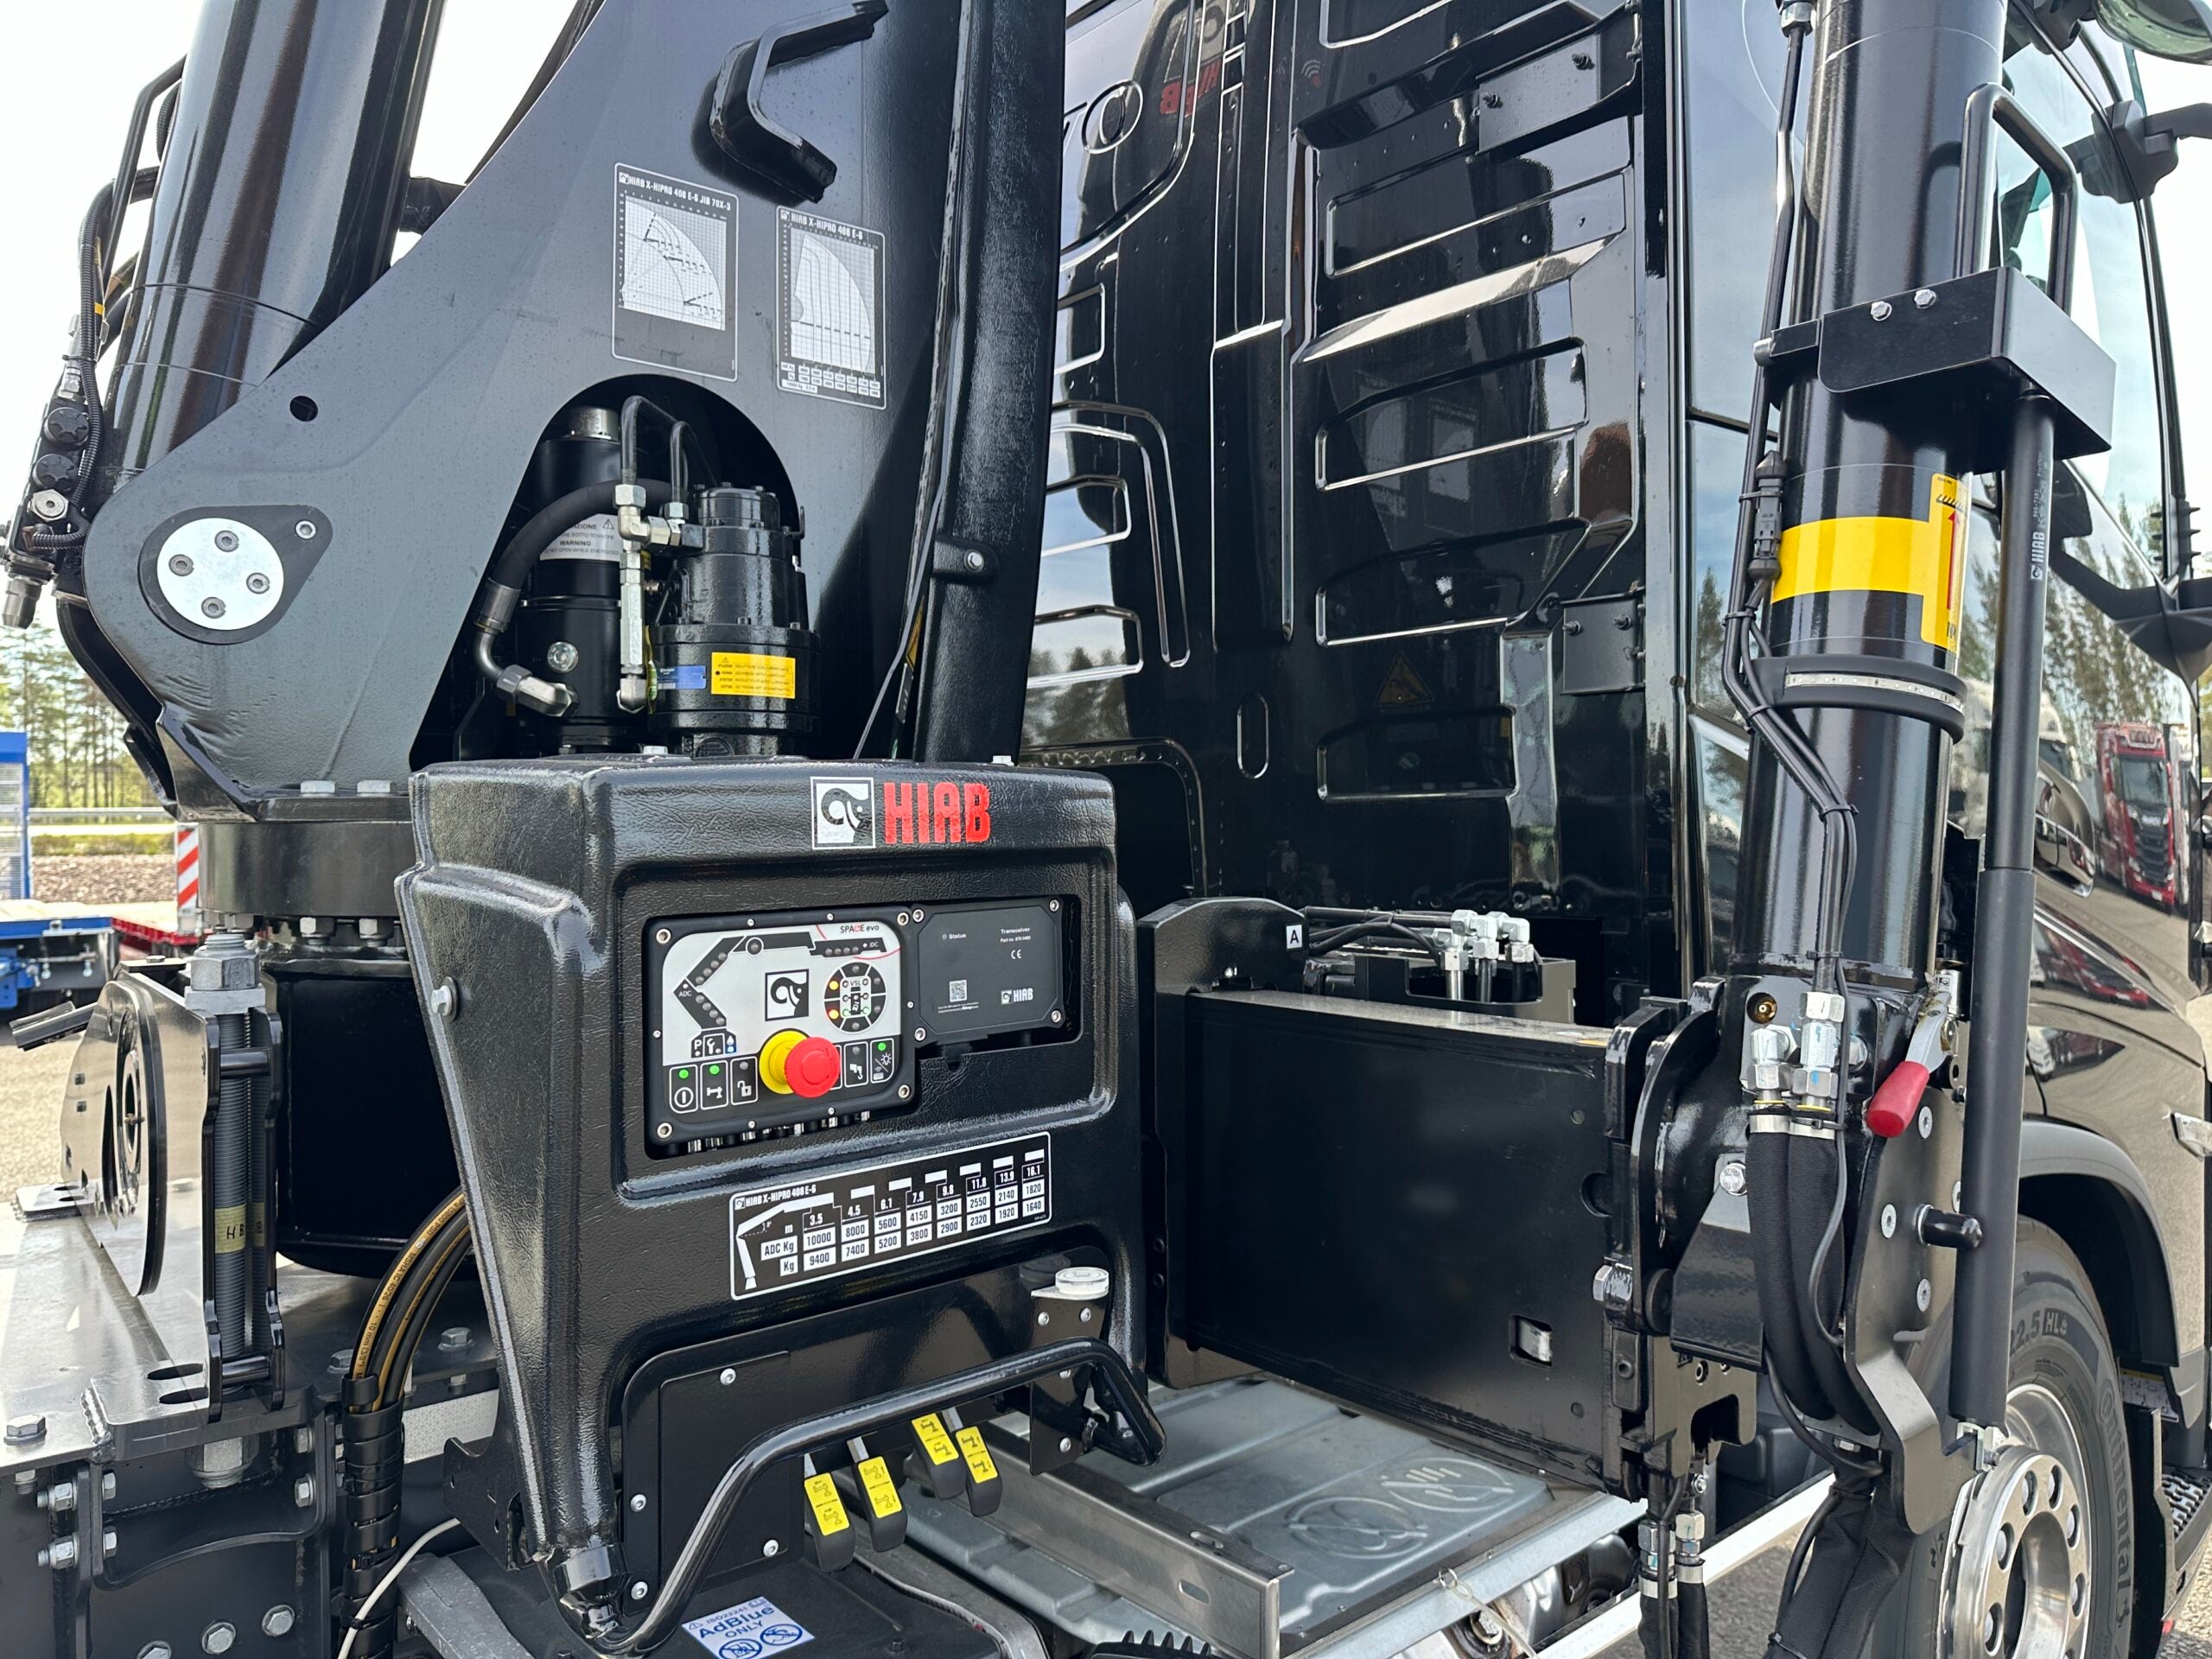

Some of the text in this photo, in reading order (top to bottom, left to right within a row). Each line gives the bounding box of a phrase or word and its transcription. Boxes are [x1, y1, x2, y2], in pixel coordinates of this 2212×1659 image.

[628, 175, 645, 188] HIAB
[645, 180, 673, 195] X-HIPRO
[688, 192, 698, 202] E-6
[700, 195, 710, 206] JIB
[712, 198, 731, 211] 70X-3
[791, 213, 807, 225] HIAB
[808, 217, 836, 233] X-HIPRO
[852, 228, 863, 240] E-6
[2031, 531, 2045, 562] HIAB
[883, 782, 992, 844] HIAB
[840, 924, 865, 934] SPACE
[1290, 930, 1300, 944] A
[1013, 988, 1033, 1002] HIAB
[694, 1039, 702, 1050] P
[745, 1184, 817, 1207] HIAB X-HIPRO 408 E-6
[810, 1165, 1040, 1225] 3.5 4.5 6.1 7.9 9.8 11.8 13.9 16.1
[765, 1183, 1041, 1255] ADC Kg 10000 8000 5600 4150 3200 2550 2140 1820
[784, 1200, 1041, 1273] Kg 9400 7400 5200 3800 2900 2320 1920 1640
[399, 1251, 417, 1272] MSHA
[370, 1322, 378, 1331] 10
[2044, 1311, 2059, 1334] HL
[363, 1332, 372, 1346] mm
[2098, 1377, 2133, 1591] Continental
[698, 1606, 776, 1639] AdBlue
[706, 1605, 748, 1624] ISO22241
[725, 1620, 765, 1638] ONLY
